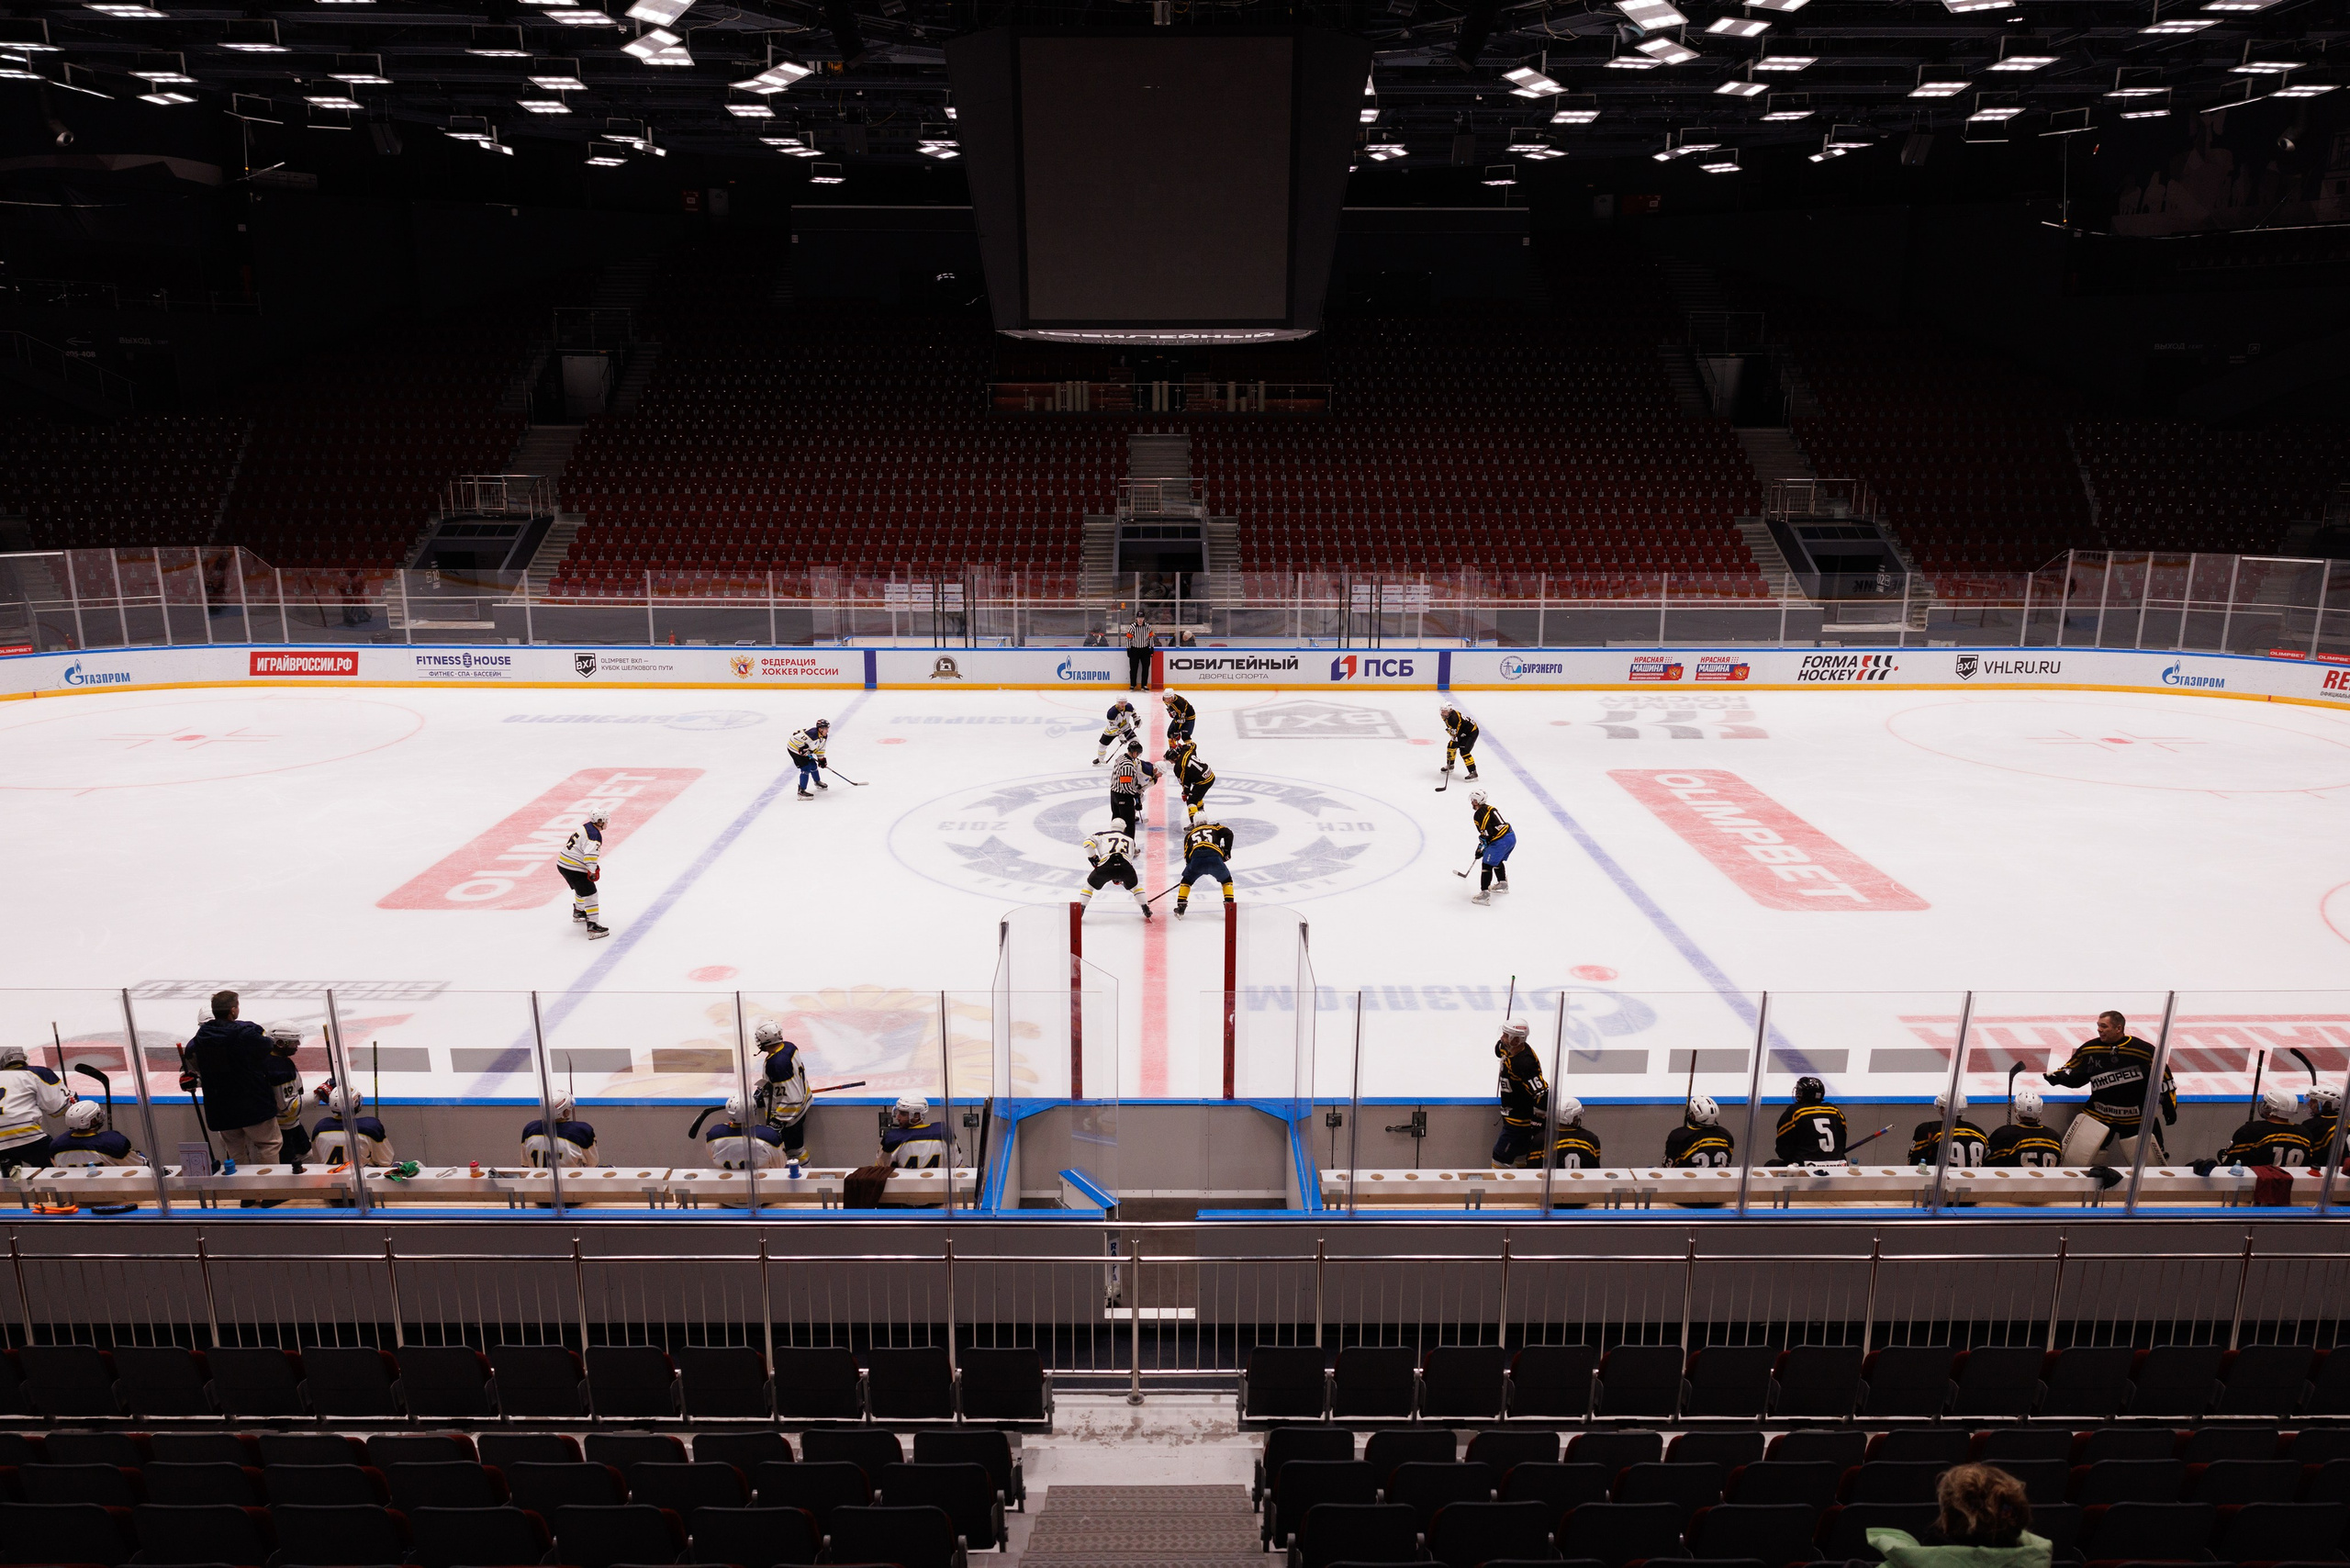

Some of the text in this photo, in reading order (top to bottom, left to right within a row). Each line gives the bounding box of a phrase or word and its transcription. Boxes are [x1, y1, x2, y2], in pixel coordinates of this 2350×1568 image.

[2154, 342, 2186, 351] ВЫХОД
[257, 655, 352, 672] ИГРАЙВРОССИИ.РФ
[416, 655, 511, 666] FITNESS HOUSE
[760, 658, 816, 667] ФЕДЕРАЦИЯ
[1169, 655, 1299, 670] ЮБИЛЕЙНЫЙ
[1802, 655, 1858, 668] FORMA
[761, 667, 839, 676] ХОККЕЯ РОССИИ
[1364, 659, 1414, 677] ПСБ
[1522, 664, 1563, 674] БУРЭНЕРГО
[1631, 664, 1664, 673] МАШИНА
[1697, 664, 1730, 673] МАШИНА
[1984, 661, 2062, 674] VHLRU.RU
[84, 672, 131, 684] ГАЗПРОМ
[1072, 671, 1111, 681] ГАЗПРОМ
[1796, 669, 1857, 681] HOCKEY
[2179, 676, 2225, 689] ГАЗПРОМ
[890, 716, 1044, 724] ГАЗПРОМ
[1191, 830, 1214, 846] 55
[1654, 773, 1874, 904] OLIMPBET
[1108, 837, 1130, 855] 73
[1528, 1077, 1543, 1092] 16
[2090, 1070, 2141, 1089] ИЖОРЕЦ
[775, 1086, 788, 1097] 22
[1813, 1118, 1835, 1152] 5
